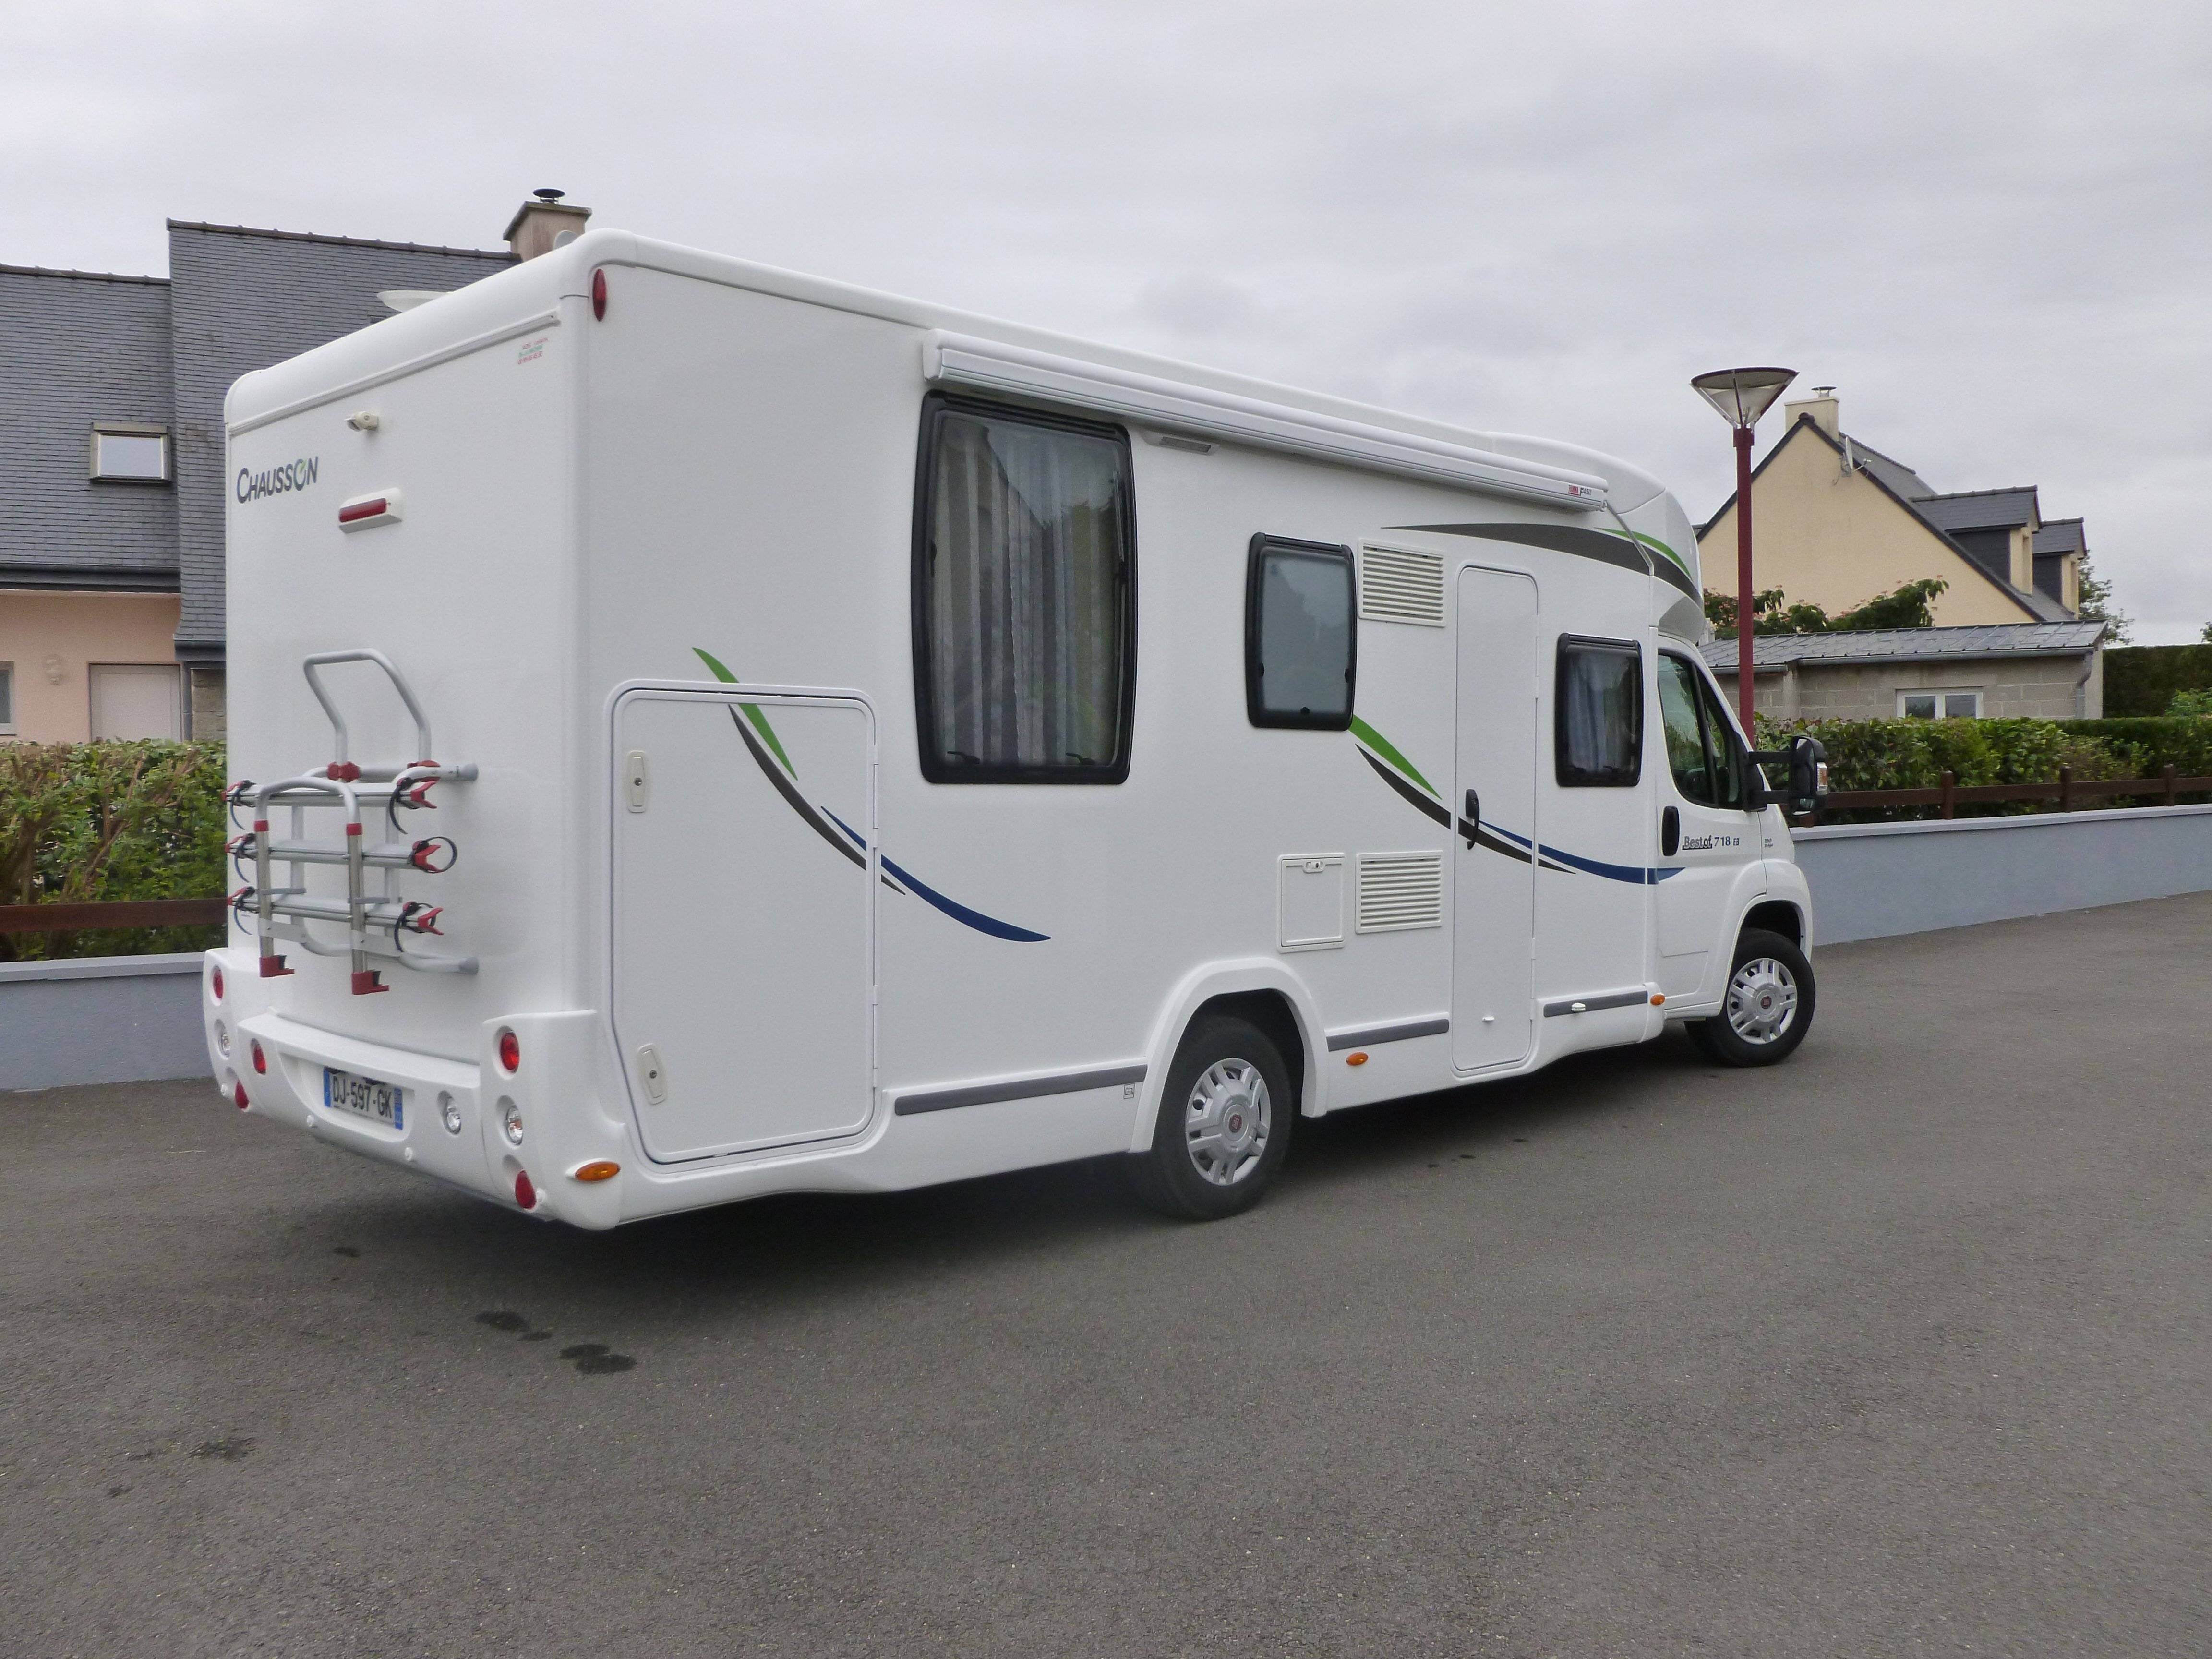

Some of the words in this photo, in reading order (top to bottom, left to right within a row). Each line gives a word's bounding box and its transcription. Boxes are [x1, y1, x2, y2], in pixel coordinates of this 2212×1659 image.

[237, 456, 318, 503] CHAUSSON
[1684, 836, 1703, 849] Best
[1714, 836, 1731, 847] 718
[333, 1076, 392, 1118] DJ-597-GK
